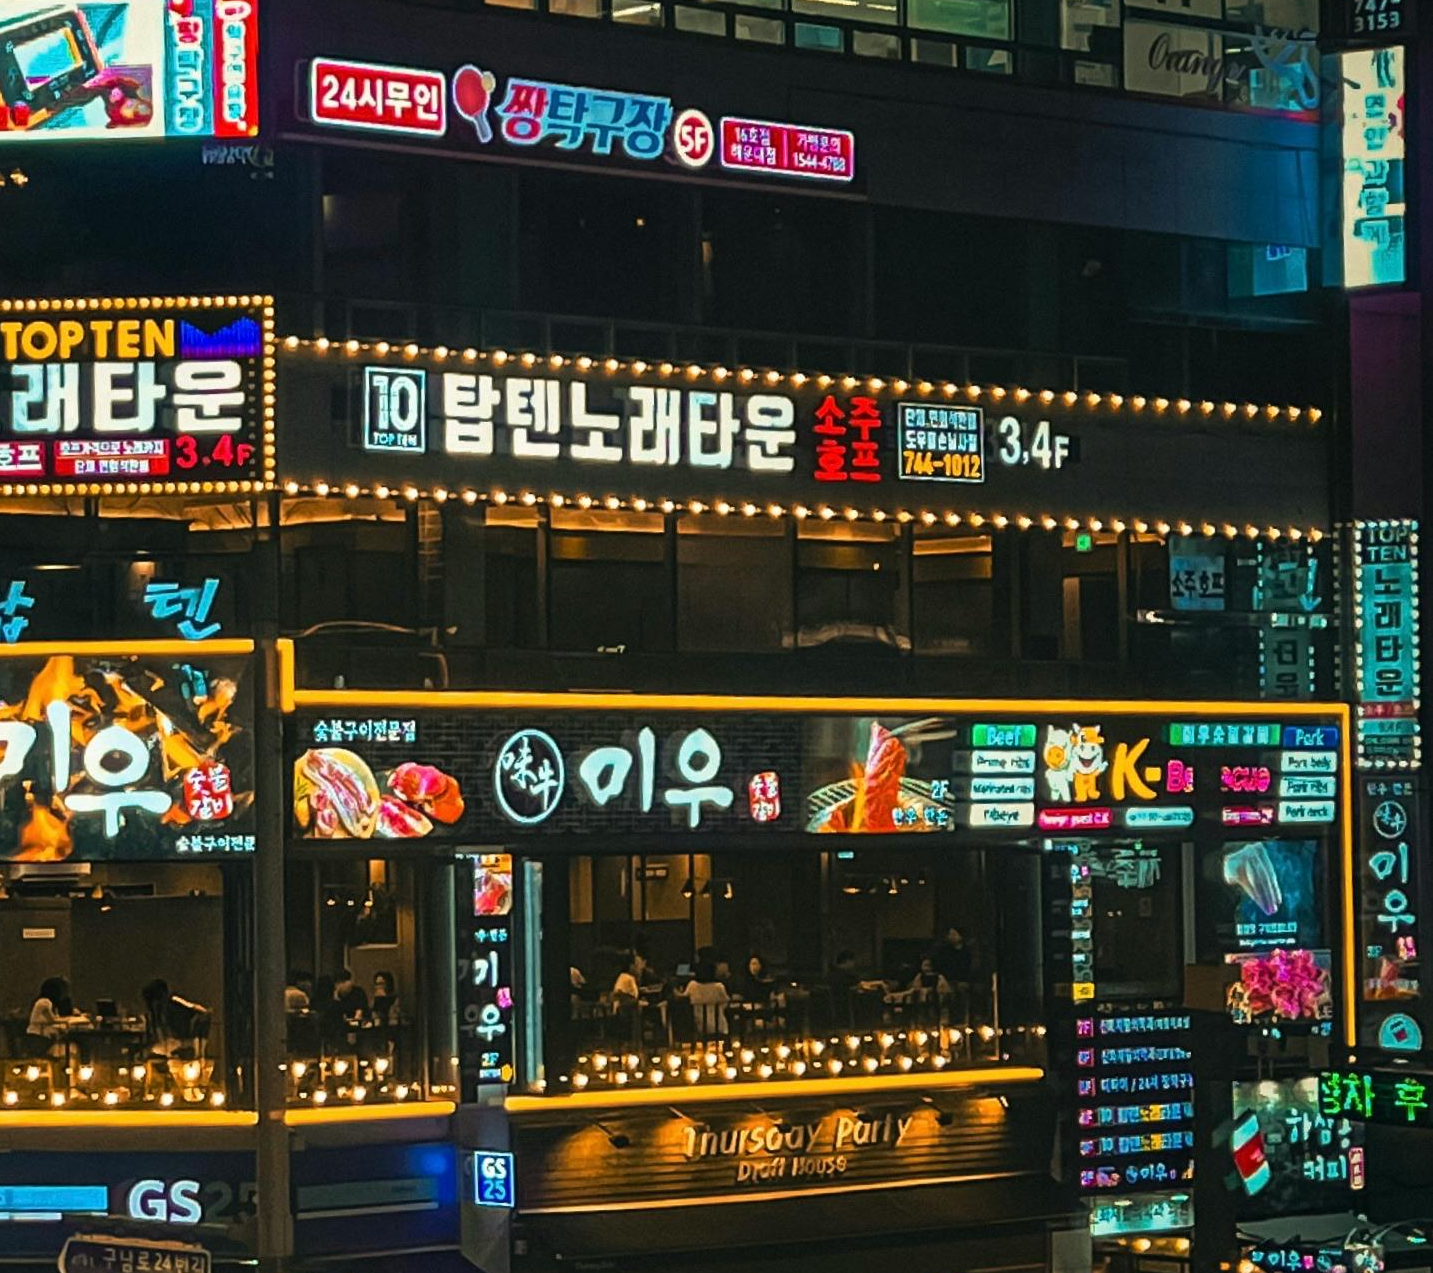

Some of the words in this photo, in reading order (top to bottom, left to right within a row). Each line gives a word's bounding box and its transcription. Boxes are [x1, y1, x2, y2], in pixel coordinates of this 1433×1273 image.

[321, 72, 439, 123] 24시무인
[503, 79, 670, 158] 짱탁구장
[678, 124, 708, 156] 5F
[372, 374, 418, 431] 10
[813, 394, 882, 441] 소주
[442, 371, 796, 473] 탑텐노래타운
[813, 439, 883, 483] 호프
[1367, 528, 1408, 543] TOP
[1367, 546, 1407, 560] TEN
[1373, 568, 1404, 698] 노래타운
[314, 718, 417, 743] 숯불구이전문점
[986, 726, 1022, 746] Beef
[1295, 728, 1325, 746] Pork
[579, 726, 734, 829] 미우
[1369, 842, 1416, 933] 미우
[681, 1121, 825, 1160] Thursday
[835, 1111, 915, 1149] Party
[481, 1156, 508, 1180] GS
[791, 1155, 848, 1178] House
[1303, 1154, 1347, 1181] 커피
[482, 1179, 507, 1201] 25
